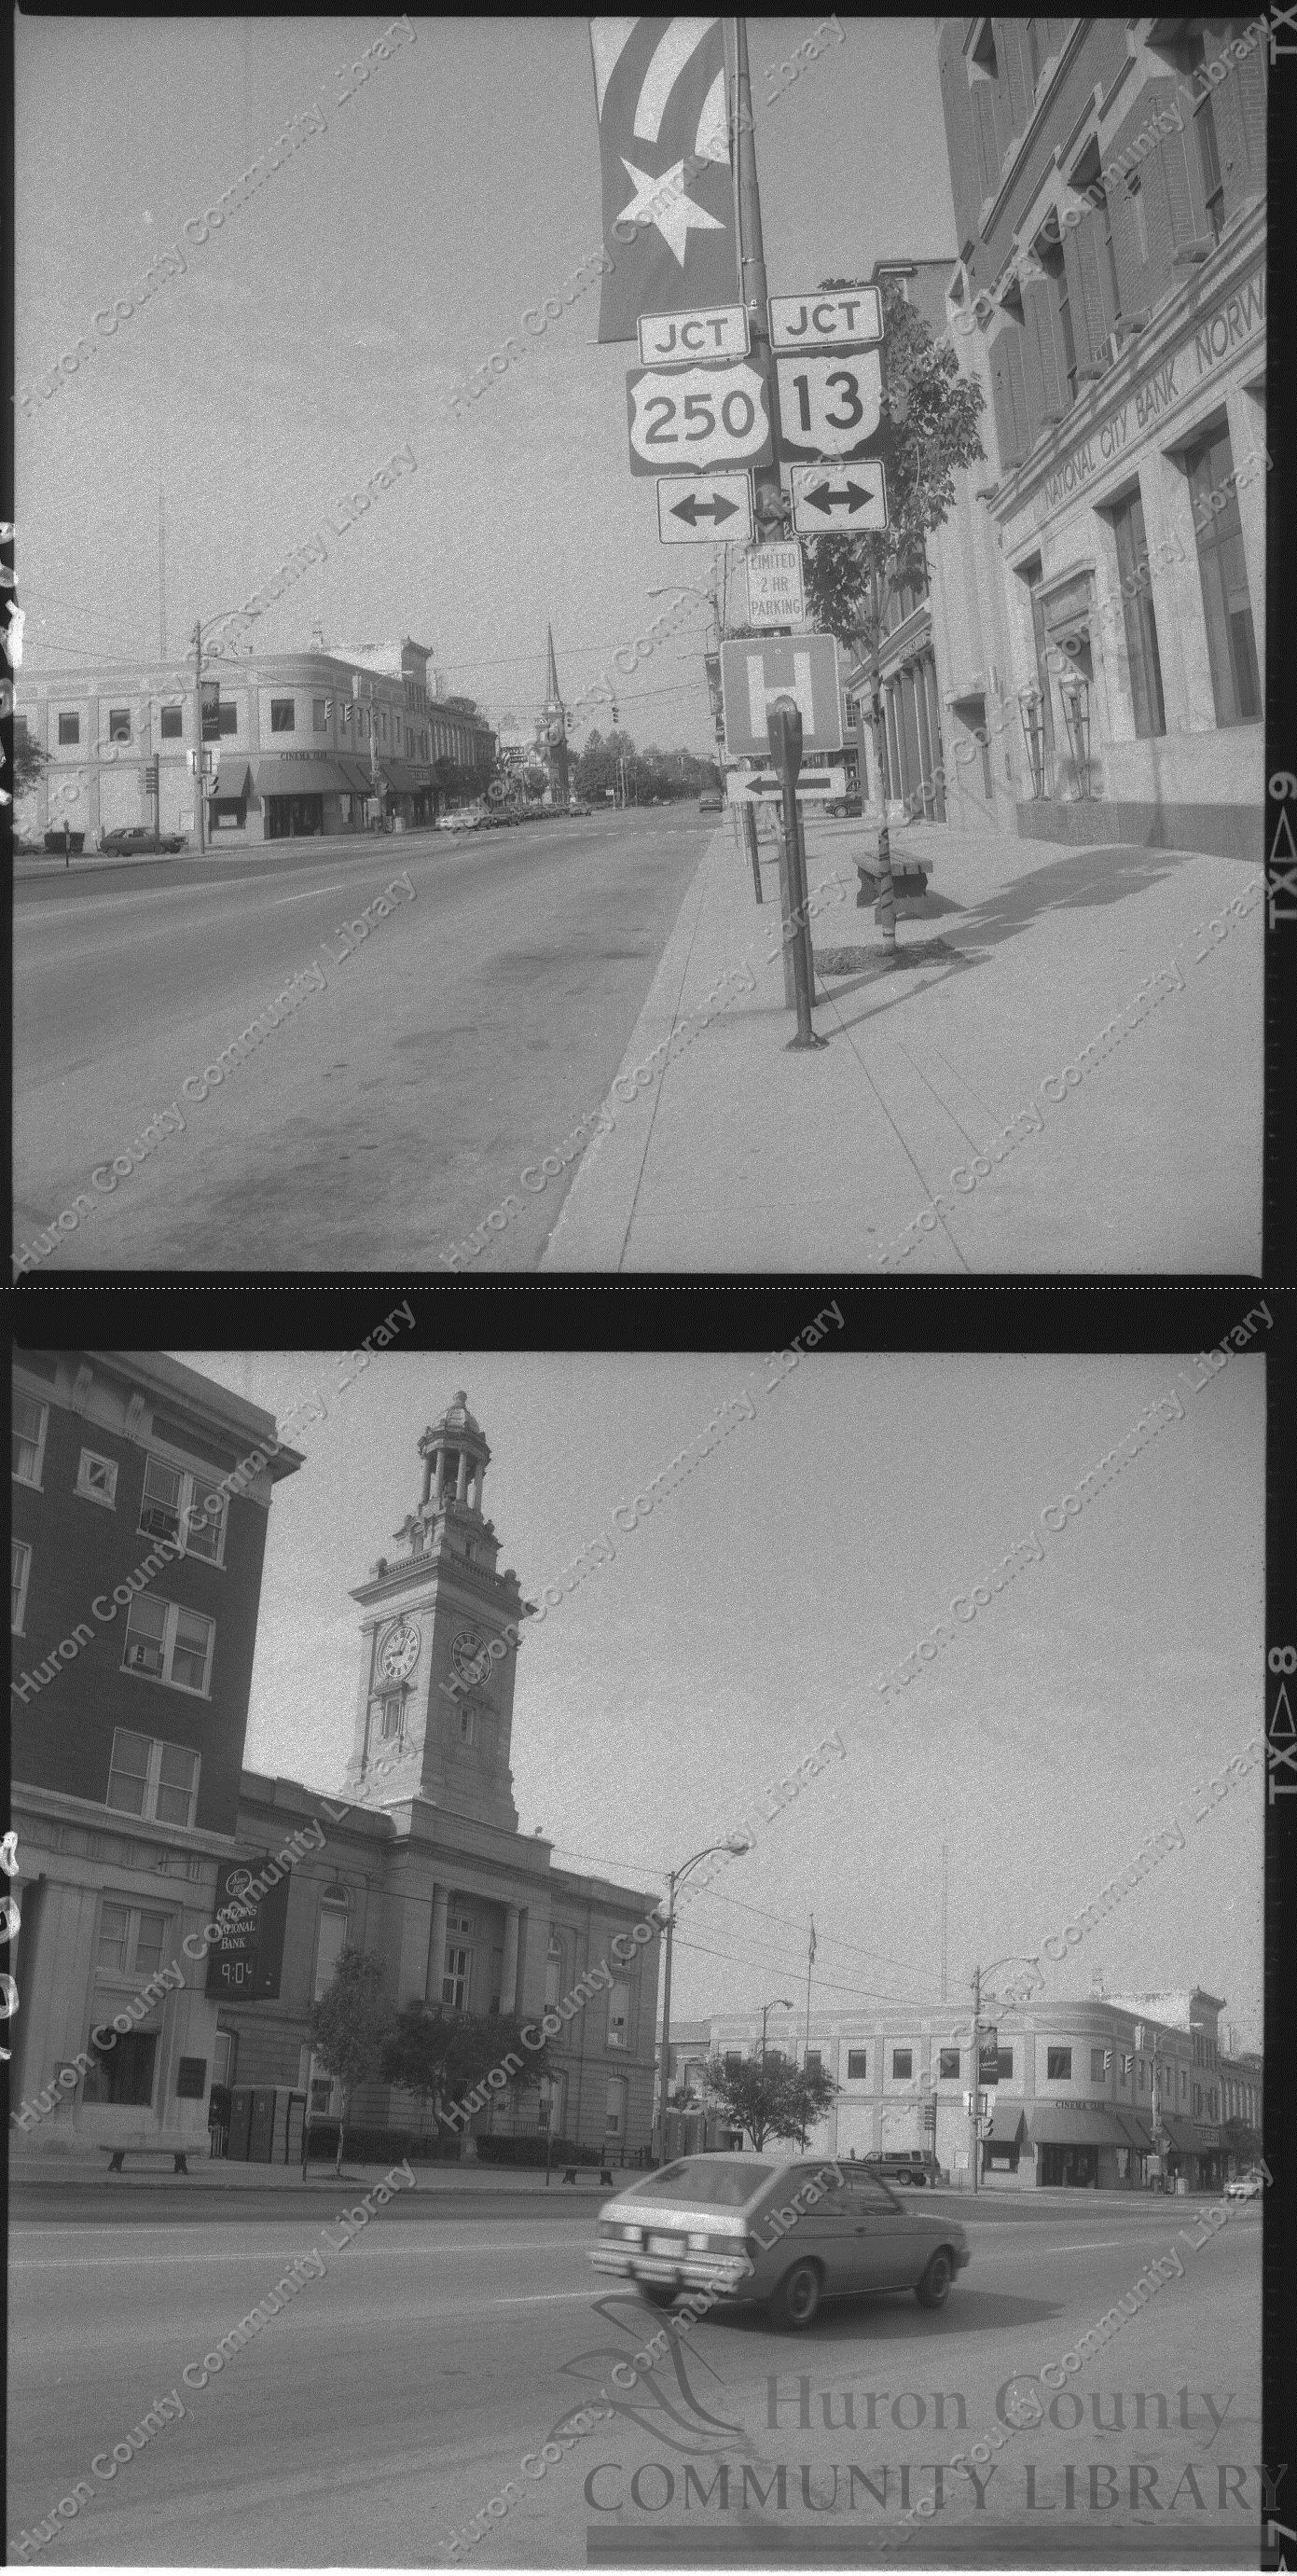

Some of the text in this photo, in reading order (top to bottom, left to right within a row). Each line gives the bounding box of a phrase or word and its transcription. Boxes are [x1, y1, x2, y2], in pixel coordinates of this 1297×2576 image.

[786, 300, 861, 335] JCT
[655, 318, 728, 353] JCT
[793, 371, 863, 431] 13
[643, 390, 755, 445] 250
[1044, 444, 1097, 510] NATIONAL
[1100, 406, 1128, 459] CITY
[1135, 357, 1179, 429] BANK
[751, 553, 795, 570] LIMITED
[761, 576, 789, 593] 2 HR
[752, 598, 801, 616] PARKING
[746, 652, 816, 739] H
[280, 751, 310, 762] CINEMA
[221, 1936, 247, 1950] BANK
[1056, 2100, 1087, 2111] CINEMA
